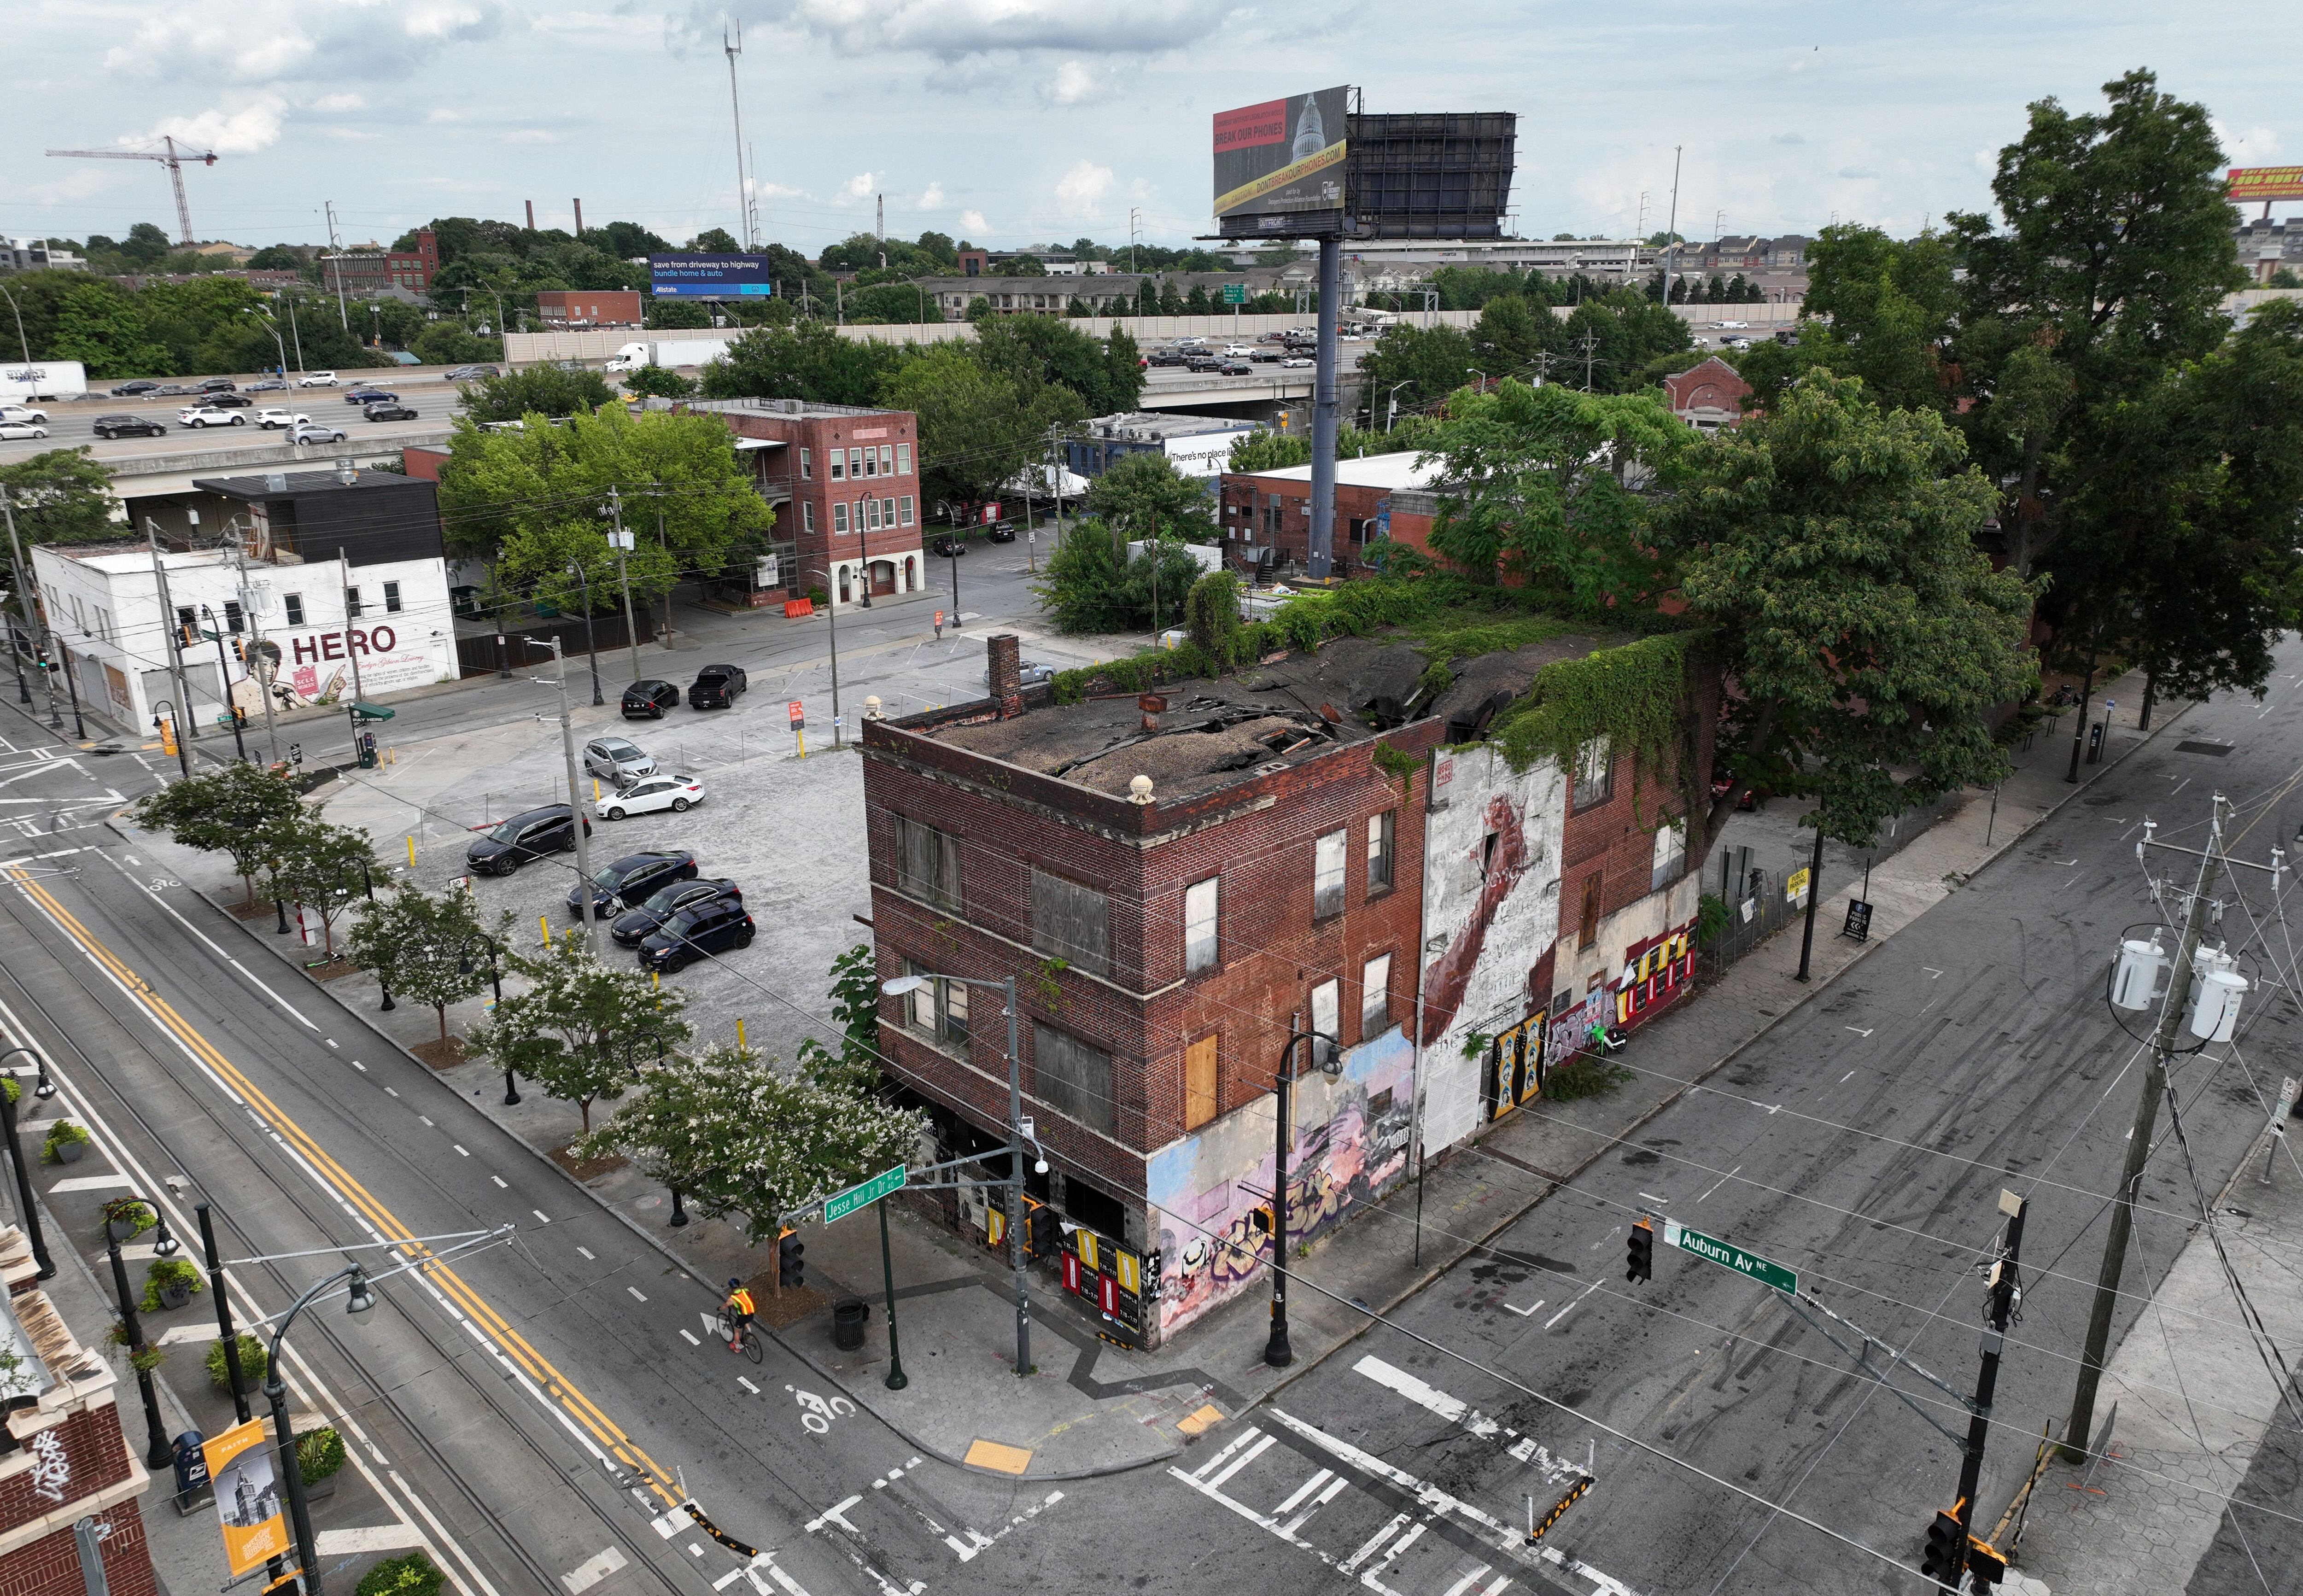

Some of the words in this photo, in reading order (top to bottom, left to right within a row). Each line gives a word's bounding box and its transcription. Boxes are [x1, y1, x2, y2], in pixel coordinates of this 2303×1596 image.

[1233, 115, 1250, 124] ANTITRUST
[1250, 112, 1270, 120] LEGISLATION
[1215, 130, 1236, 145] BREAK
[1238, 127, 1252, 141] OUR
[1254, 122, 1283, 139] PHONES
[1257, 147, 1340, 193] DONTBREAKOURPHONES.COM
[1232, 187, 1253, 204] CAUTION!
[1259, 218, 1284, 227] OUTFRONT
[1172, 451, 1196, 462] There's
[1208, 449, 1226, 460] place
[292, 626, 396, 665] HERO
[357, 661, 376, 671] Evelyn
[378, 657, 399, 668] Gibson
[401, 654, 424, 662] Lowery
[297, 677, 315, 685] SCLC
[1789, 877, 1806, 890] PARKING
[1792, 871, 1805, 882] PUBLIC
[829, 1200, 850, 1218] Jesse
[853, 1190, 865, 1206] Hill
[868, 1186, 874, 1199] Jr
[878, 1181, 885, 1194] Dr
[888, 1181, 894, 1190] 40
[1098, 1244, 1116, 1258] PURPLE
[1683, 1232, 1730, 1263] Auburn
[1735, 1254, 1753, 1271] Av
[1756, 1261, 1768, 1272] NE
[1081, 1267, 1099, 1281] PURPLE
[1099, 1263, 1117, 1277] 7.15-7.17
[1081, 1286, 1099, 1301] 7.15-7.17
[1120, 1290, 1138, 1305] PURPLE
[1120, 1310, 1138, 1324] 7.15-7.17
[222, 1437, 248, 1453] FAITH
[242, 1530, 262, 1552] SWEET
[244, 1533, 270, 1559] AUBURN
